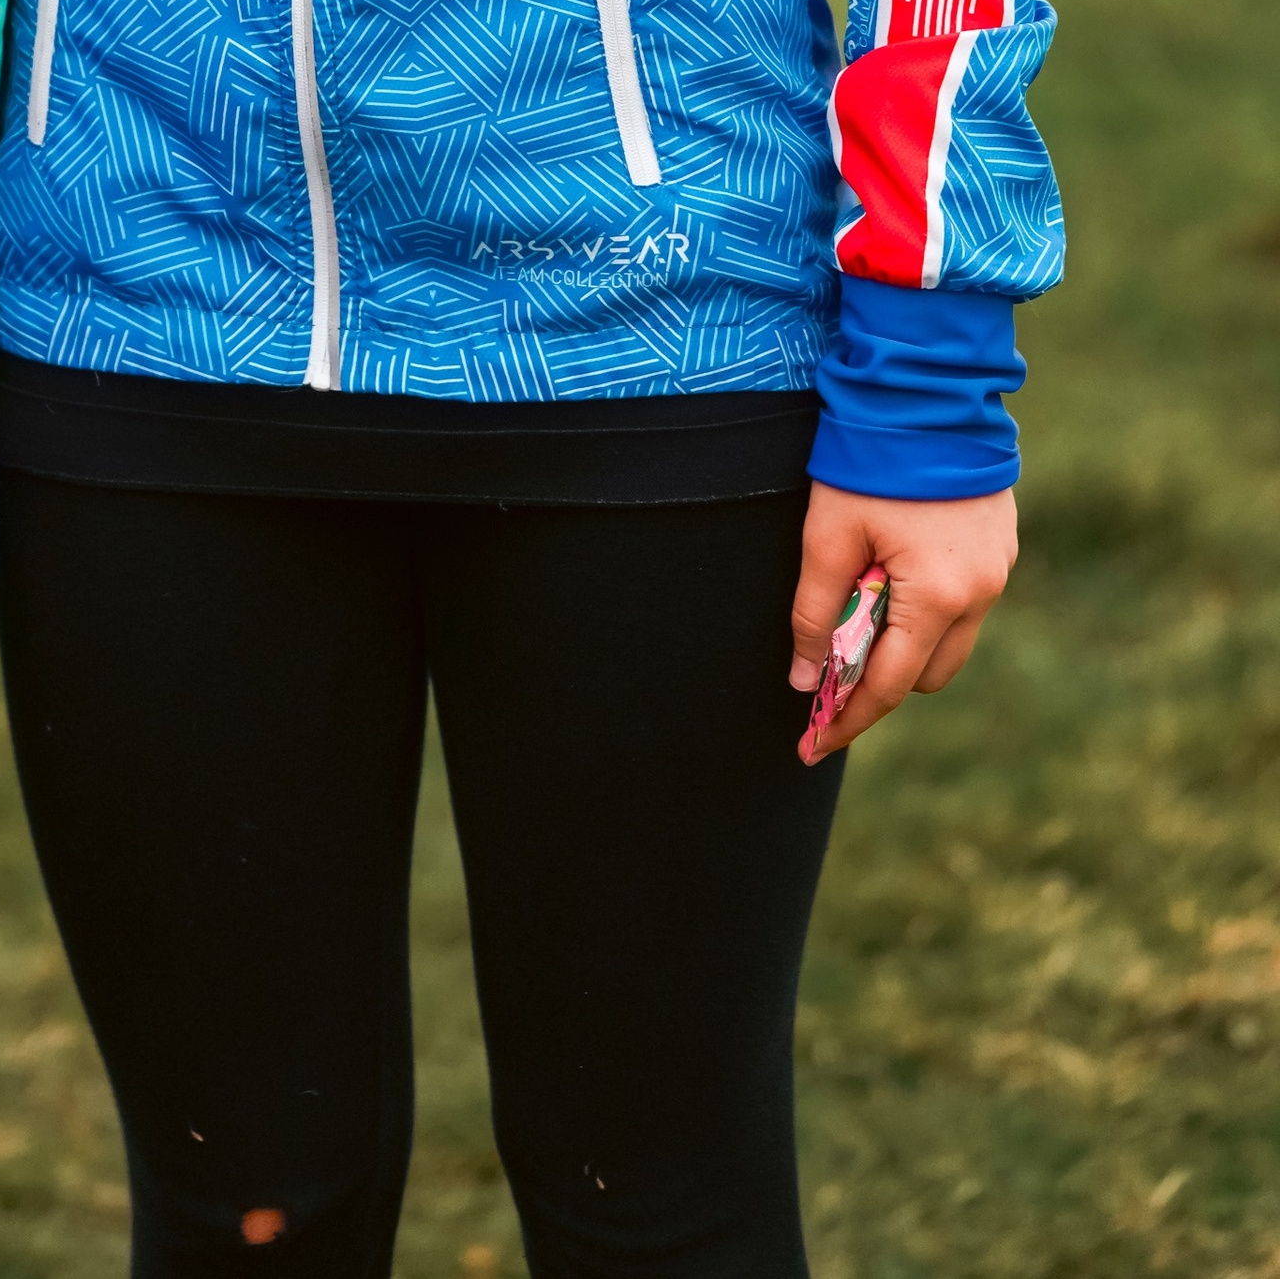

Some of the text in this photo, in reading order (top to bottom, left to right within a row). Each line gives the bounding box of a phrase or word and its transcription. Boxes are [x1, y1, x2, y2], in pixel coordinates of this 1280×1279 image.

[471, 233, 690, 265] ARSWEAR
[497, 266, 669, 289] TEAM COLLECTION
